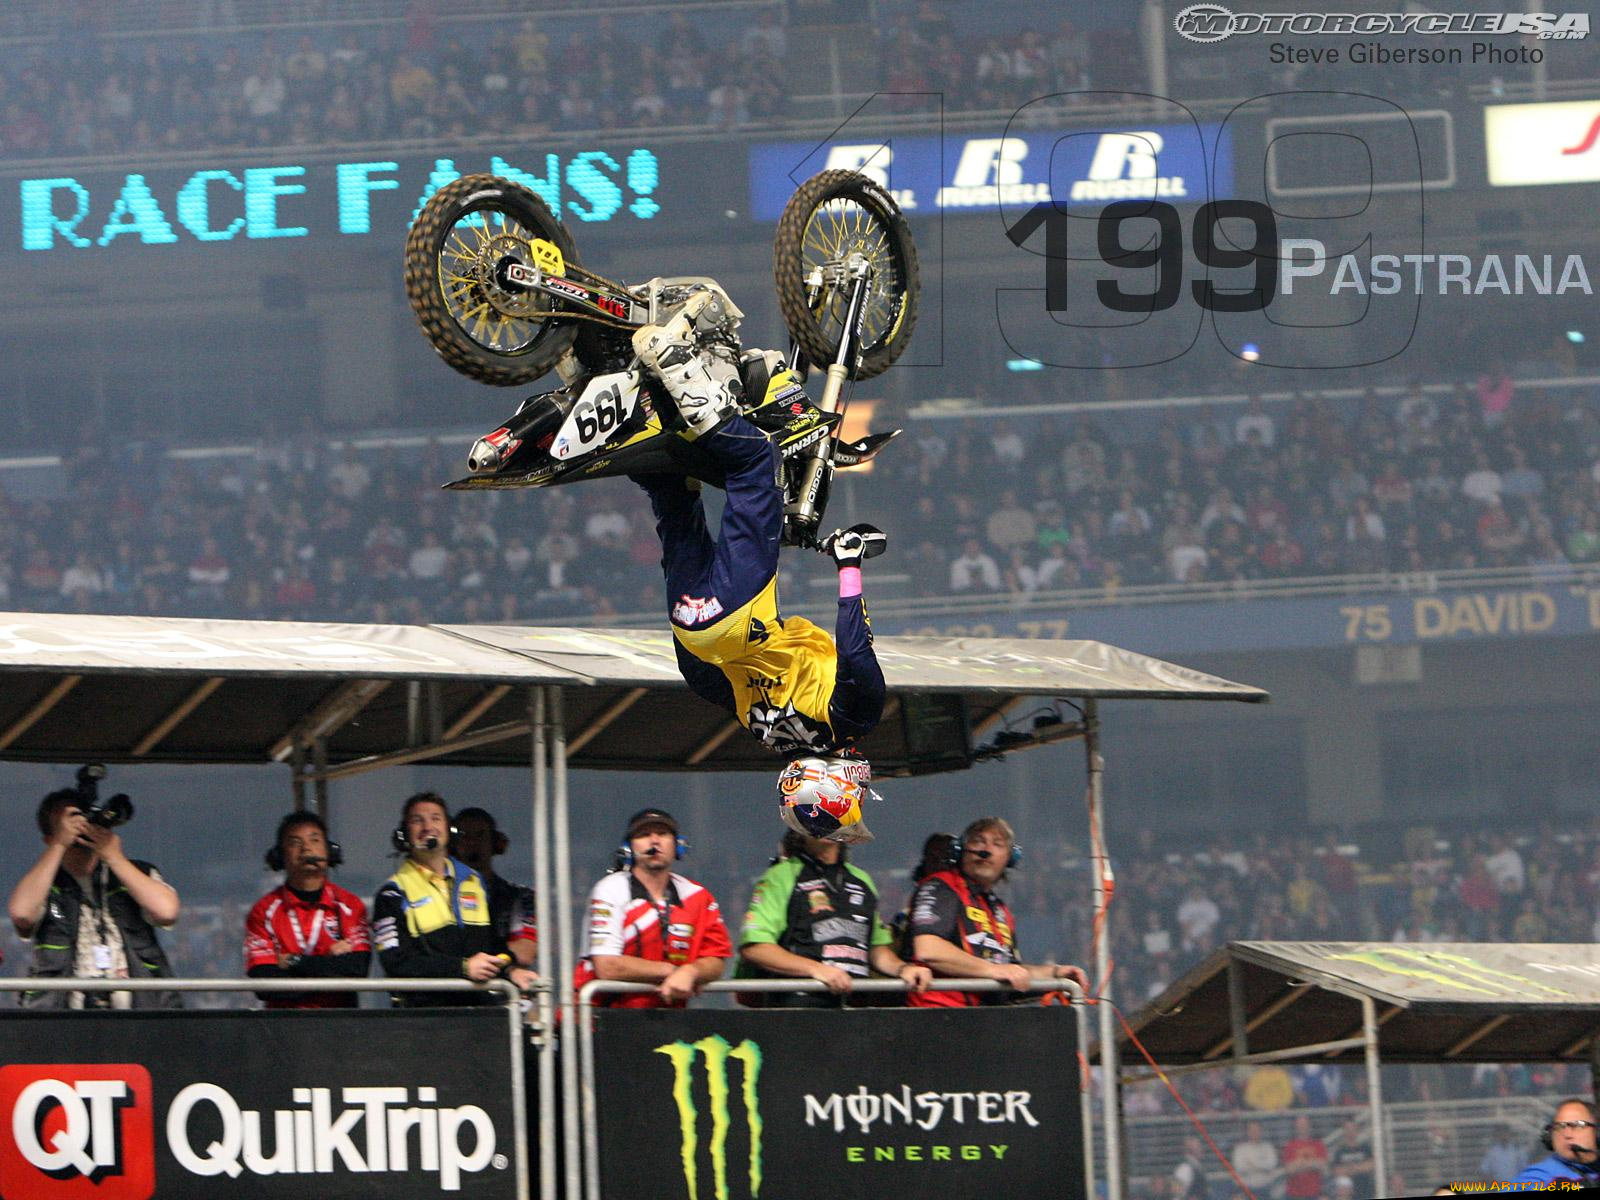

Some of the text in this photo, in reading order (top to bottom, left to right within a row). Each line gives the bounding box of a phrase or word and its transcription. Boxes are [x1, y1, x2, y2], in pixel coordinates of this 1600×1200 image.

[20, 166, 309, 250] RACE
[573, 383, 627, 444] 199
[808, 467, 823, 503] OGIO
[1340, 606, 1392, 641] 75
[1414, 592, 1556, 638] DAVID
[804, 1084, 1039, 1133] MONSTER
[12, 1079, 498, 1190] QT QuikTrip
[846, 1144, 1009, 1162] ENERGY
